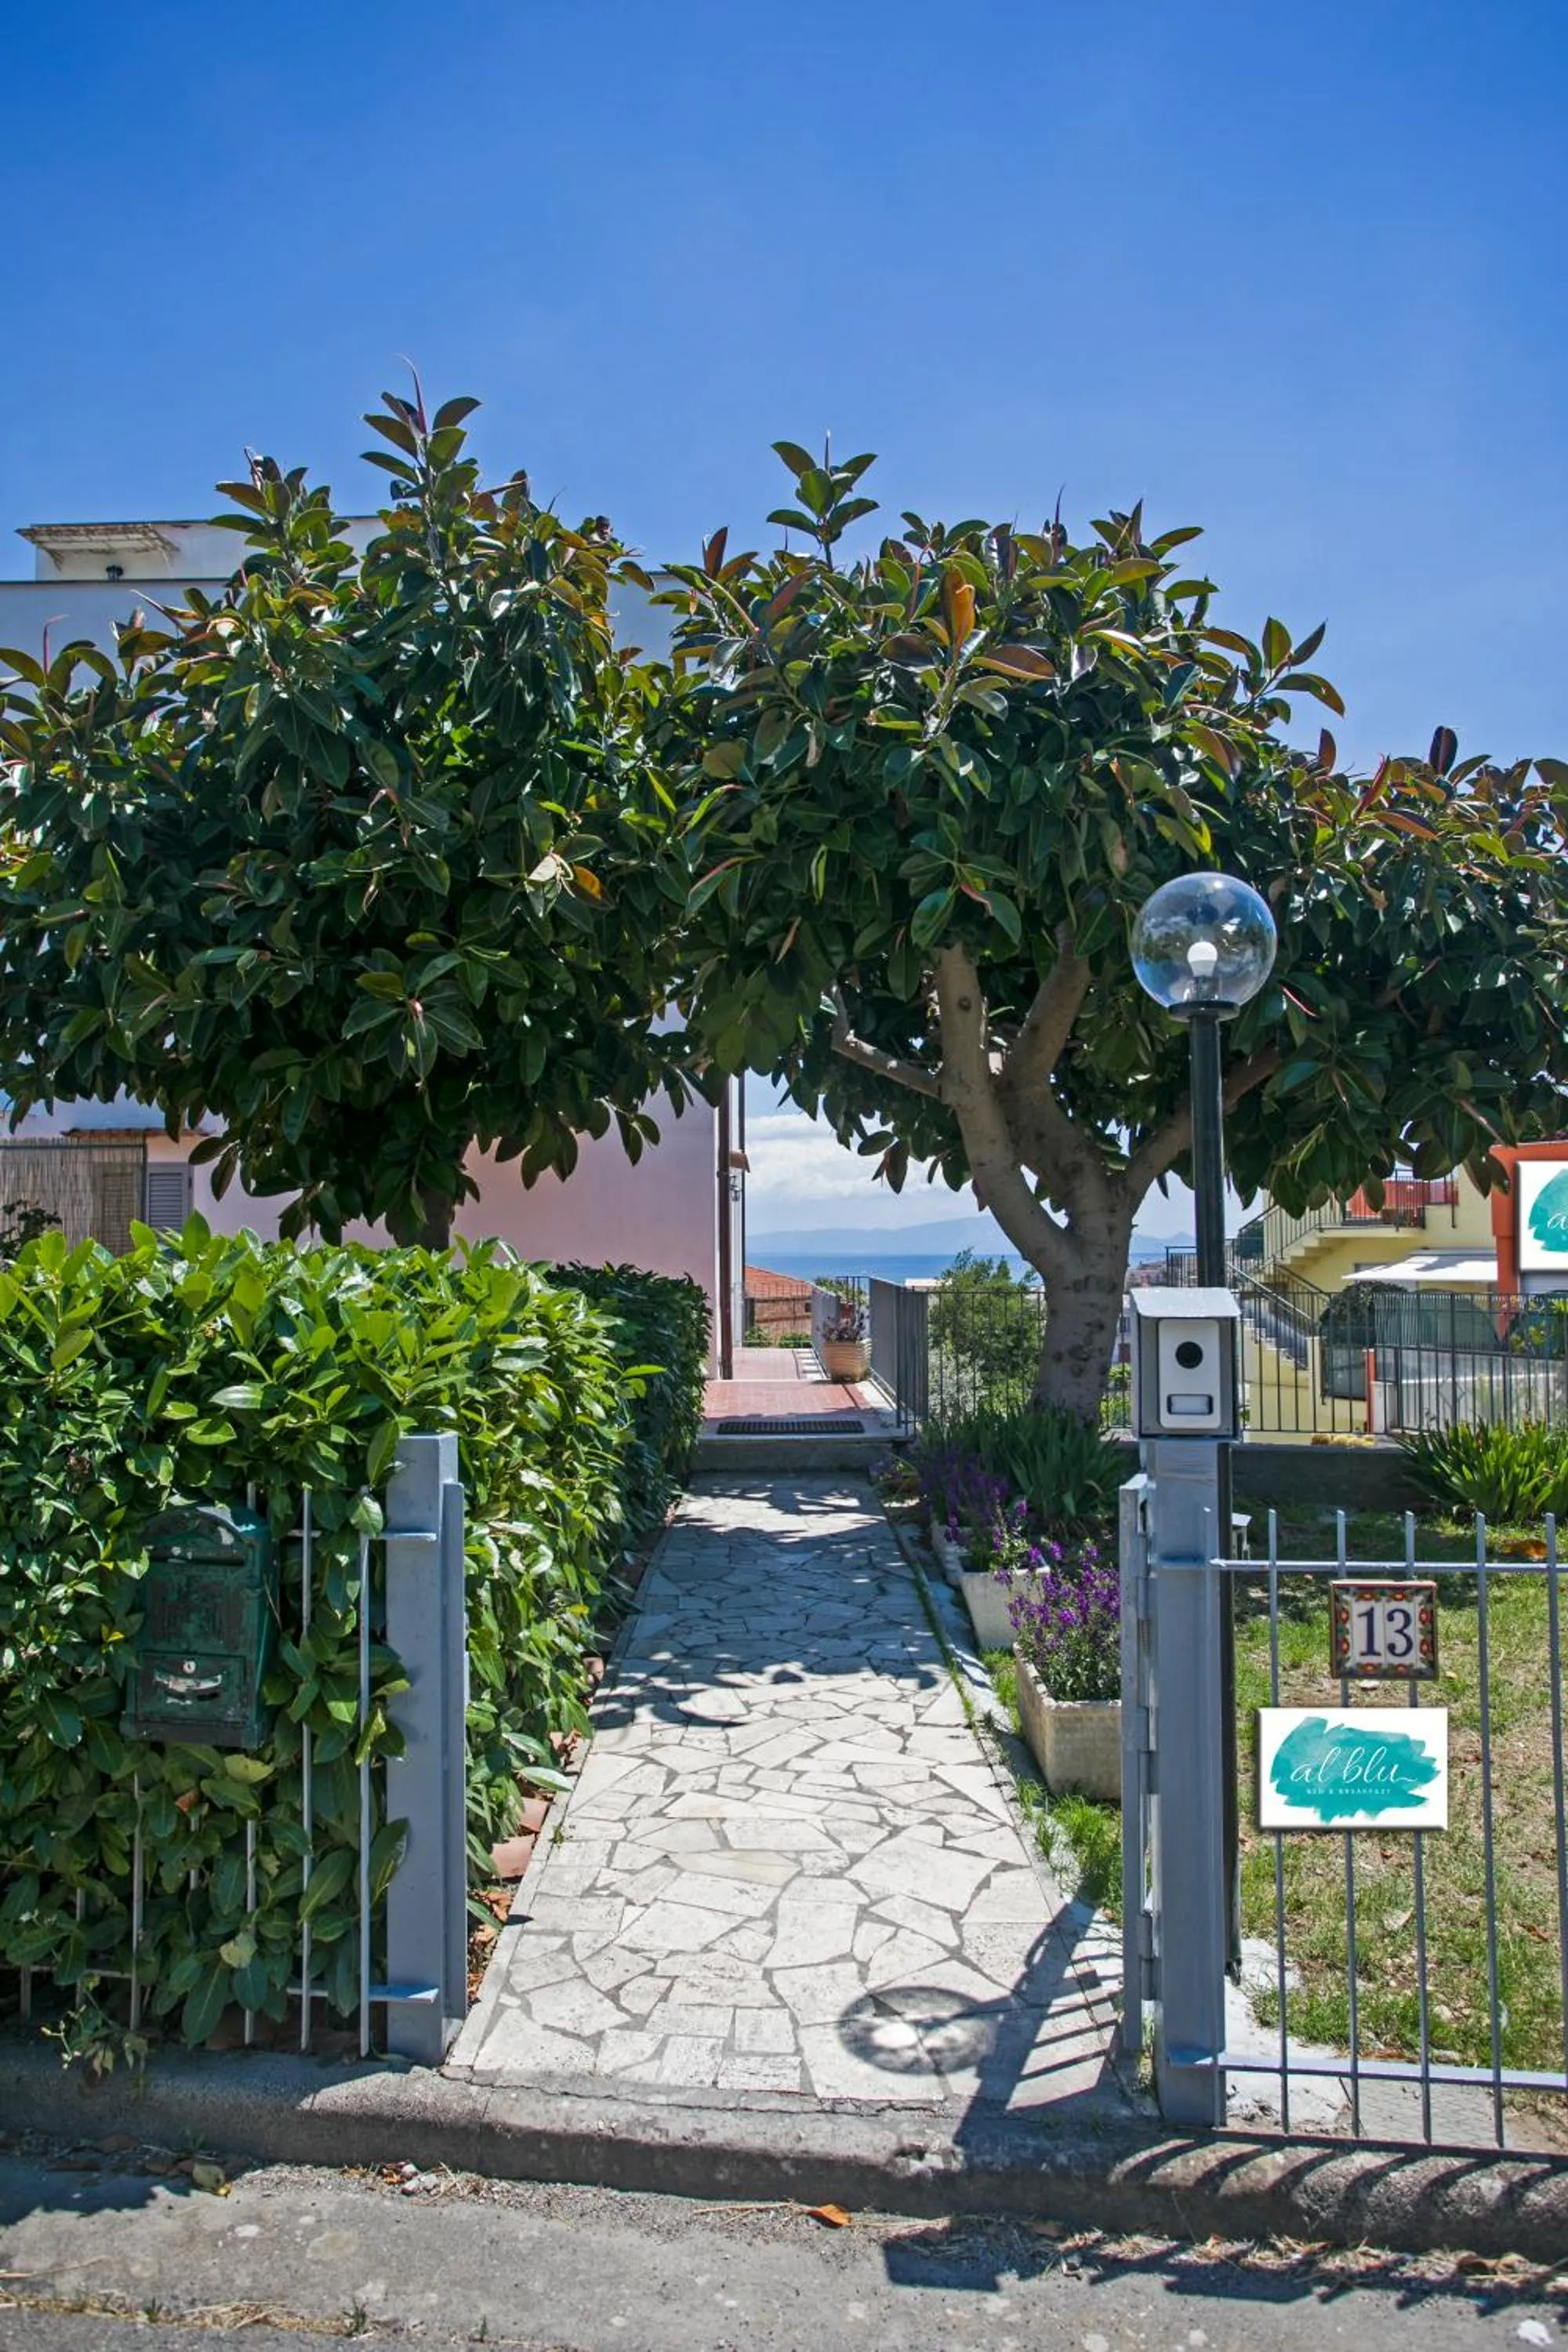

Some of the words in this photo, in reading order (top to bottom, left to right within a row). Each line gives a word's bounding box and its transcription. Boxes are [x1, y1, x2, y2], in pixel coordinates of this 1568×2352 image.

[1358, 1606, 1414, 1657] 13
[1290, 1746, 1341, 1783] al
[1342, 1746, 1418, 1784] blu
